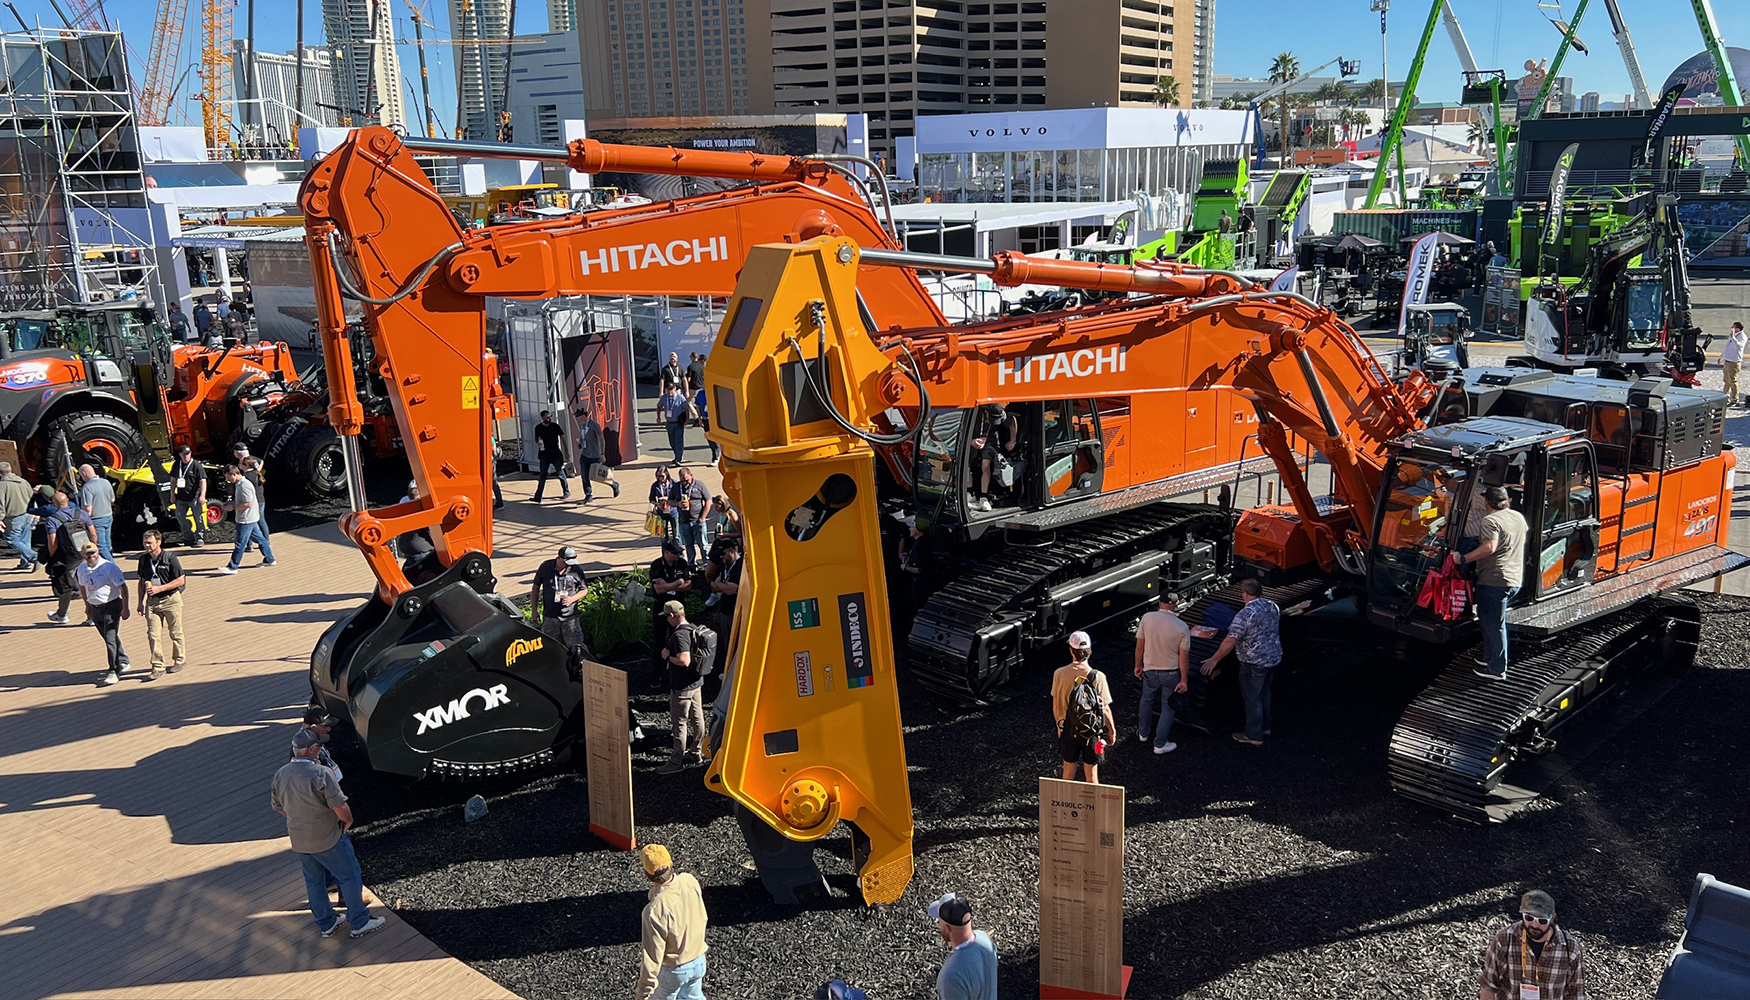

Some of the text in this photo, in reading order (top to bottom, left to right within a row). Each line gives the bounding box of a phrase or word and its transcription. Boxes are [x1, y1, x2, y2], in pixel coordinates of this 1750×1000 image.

[968, 126, 1047, 138] VOLVO
[693, 138, 756, 148] POWER YOUR AMBITION
[1412, 217, 1450, 225] MACHINES
[579, 236, 728, 275] HITACHI
[1411, 243, 1430, 304] ROMEK
[241, 363, 270, 379] HITA
[998, 346, 1126, 386] HITACHI
[14, 371, 47, 385] 370
[269, 416, 302, 458] HITACHI
[1687, 495, 1717, 509] LANDCROS
[1683, 514, 1716, 538] 490
[793, 611, 803, 628] ISS
[847, 602, 863, 657] INDECO
[796, 656, 808, 694] HARDOX
[412, 683, 511, 736] XMOR
[1050, 800, 1095, 811] ZX490LC-7H
